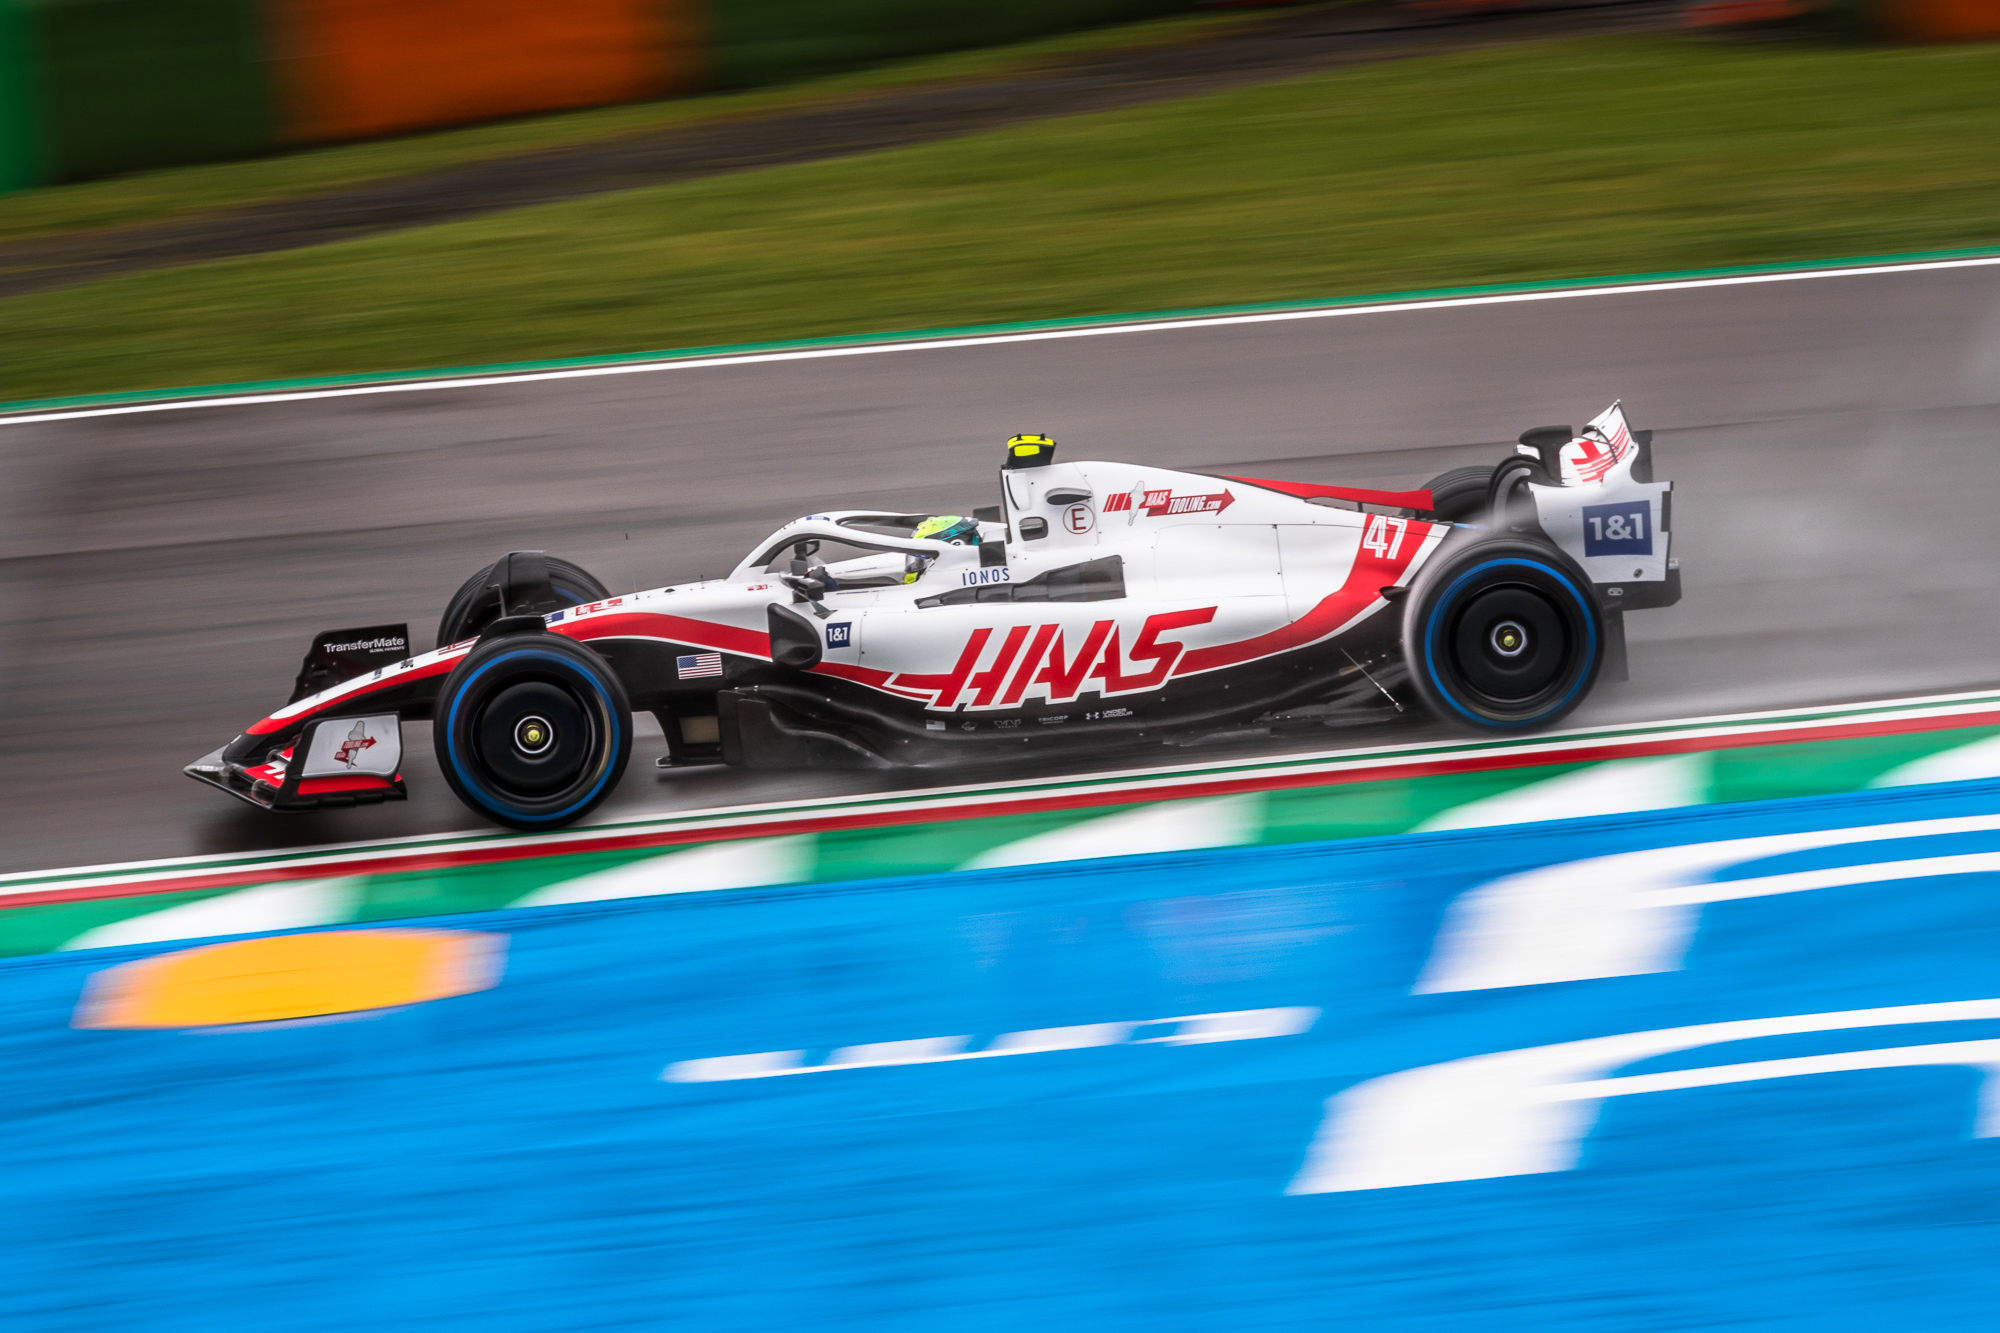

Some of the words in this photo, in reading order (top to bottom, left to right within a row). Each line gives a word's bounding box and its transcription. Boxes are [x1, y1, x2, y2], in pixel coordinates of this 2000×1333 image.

[1145, 491, 1168, 507] HAAS
[1071, 508, 1087, 531] E
[1588, 513, 1644, 543] 1&1
[1362, 515, 1408, 560] 47
[962, 567, 1011, 586] IONOS
[827, 626, 849, 642] 1&1
[323, 637, 405, 653] TransferMate
[891, 606, 1218, 708] HAAS
[1102, 707, 1127, 715] UNDER
[1102, 711, 1133, 719] ARMOUR
